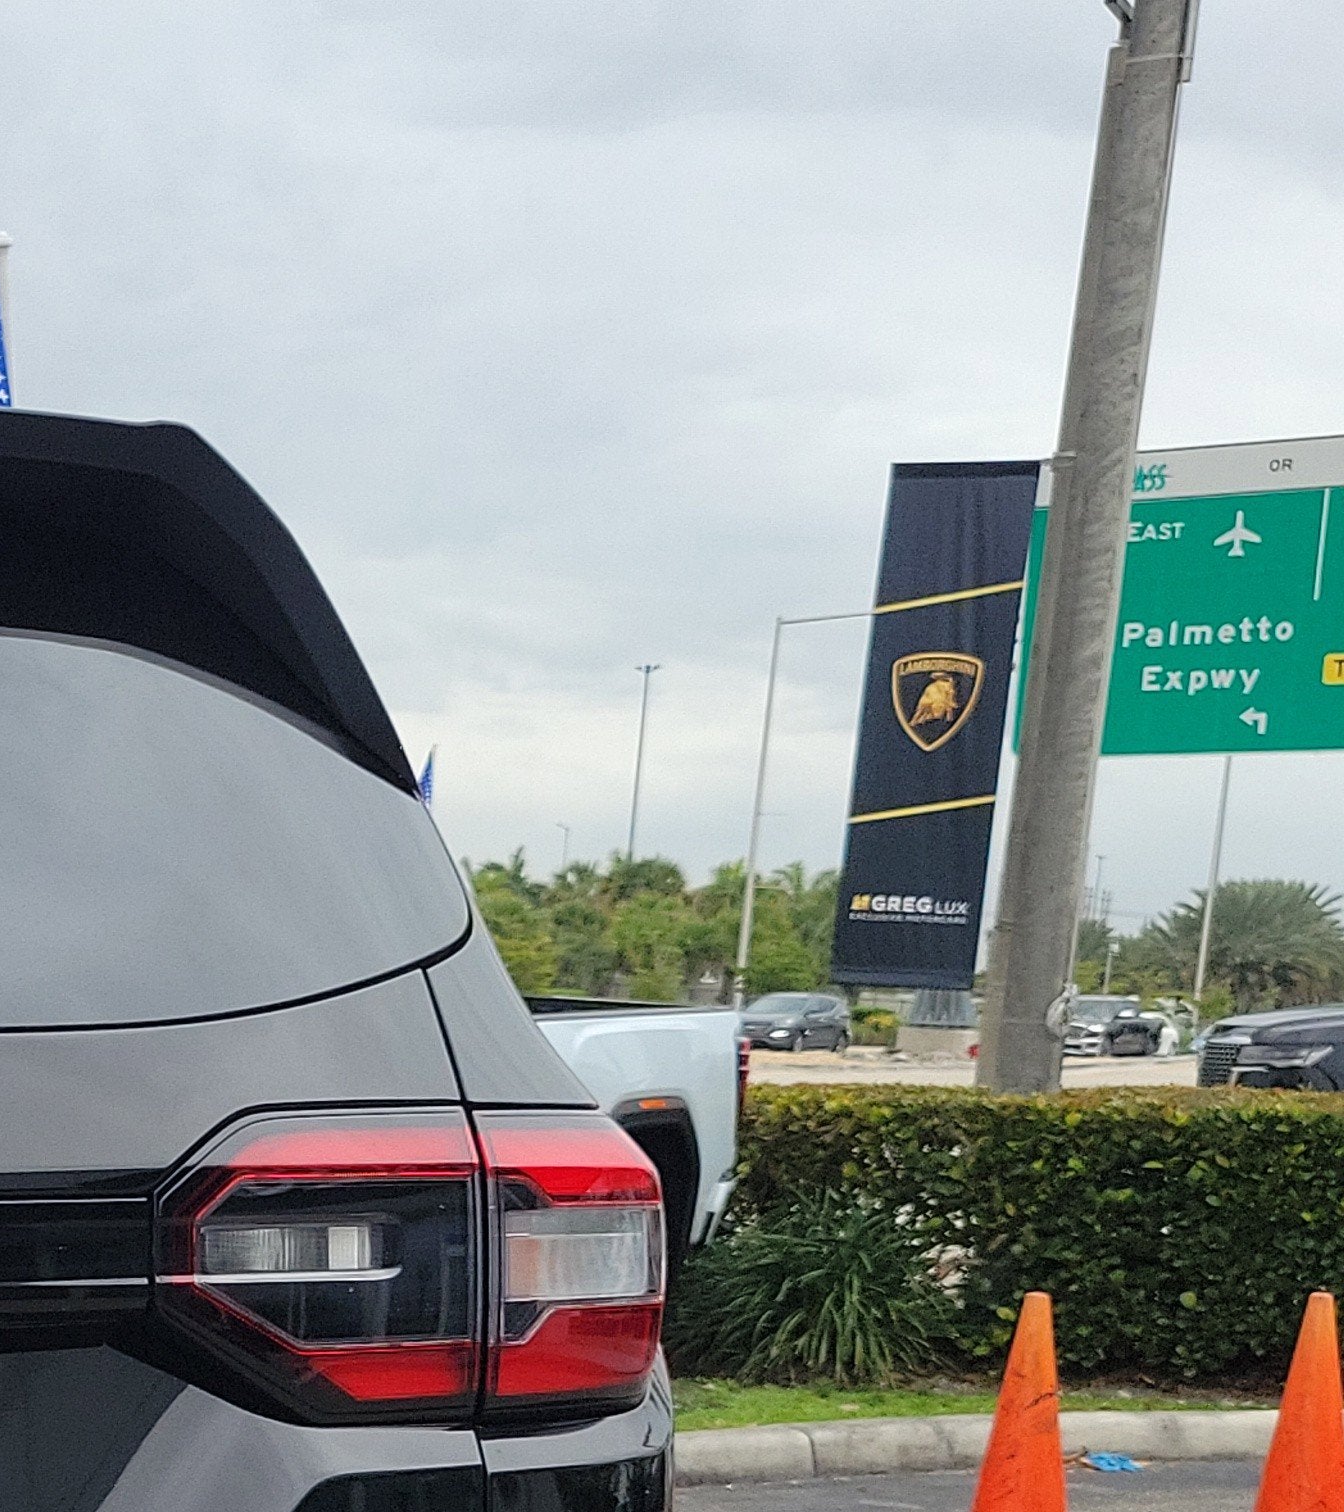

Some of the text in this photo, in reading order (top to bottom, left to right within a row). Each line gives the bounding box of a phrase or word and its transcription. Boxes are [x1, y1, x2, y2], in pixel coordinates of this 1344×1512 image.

[1268, 457, 1294, 473] OR
[1126, 521, 1186, 543] EAST
[1121, 615, 1295, 649] Palmetto
[1140, 664, 1261, 696] Expwy
